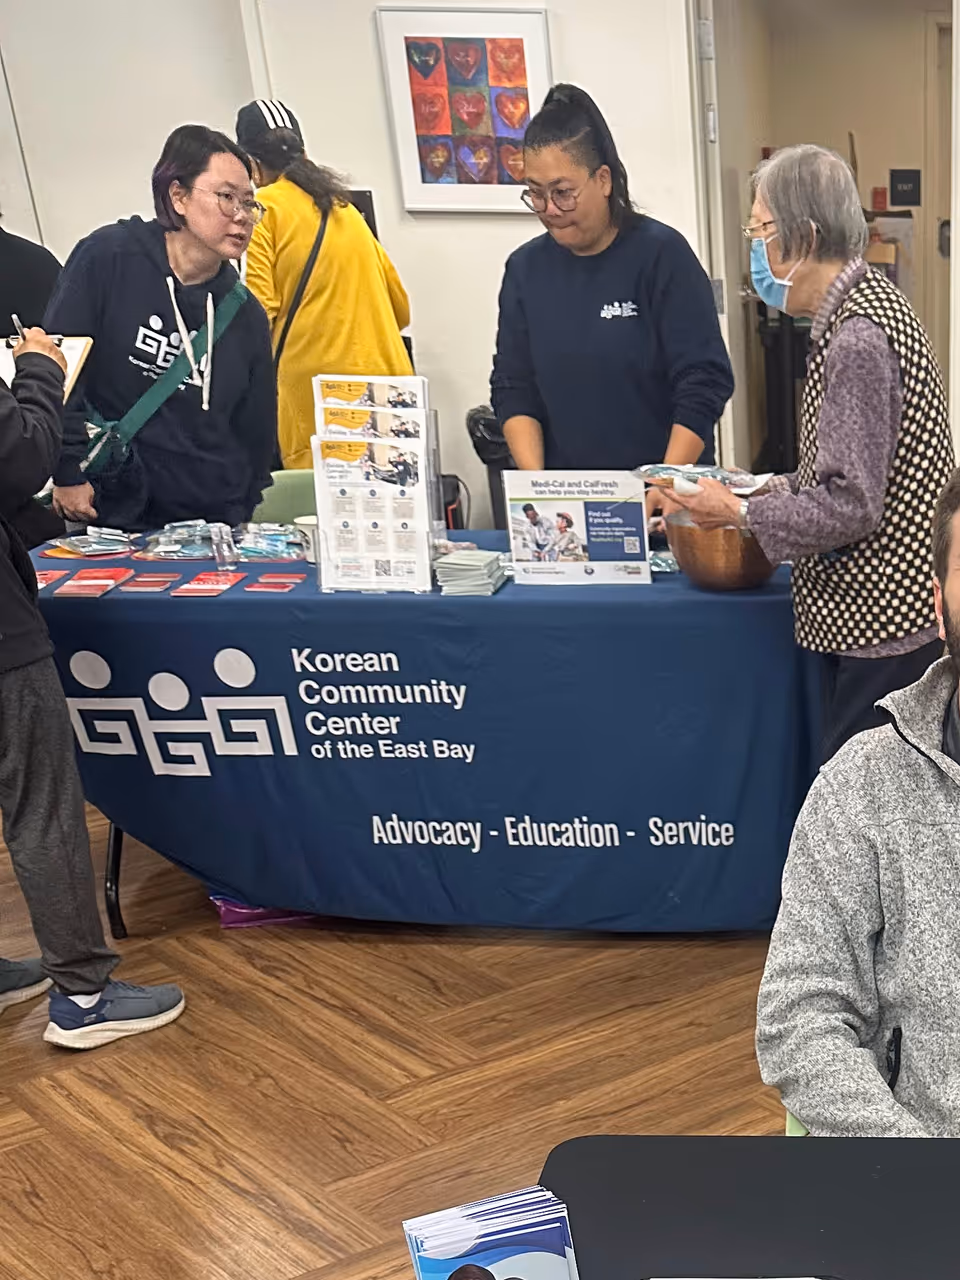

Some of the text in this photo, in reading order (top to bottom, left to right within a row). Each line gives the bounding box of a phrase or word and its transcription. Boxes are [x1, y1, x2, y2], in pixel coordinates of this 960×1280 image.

[531, 480, 618, 488] Medi-Cal and CalFresh
[291, 648, 400, 673] Korean
[298, 679, 467, 710] Community
[305, 711, 401, 736] Center
[310, 740, 475, 763] of the East Bay
[372, 813, 482, 853] Advocacy
[504, 815, 620, 848] Education
[648, 815, 735, 847] Service
